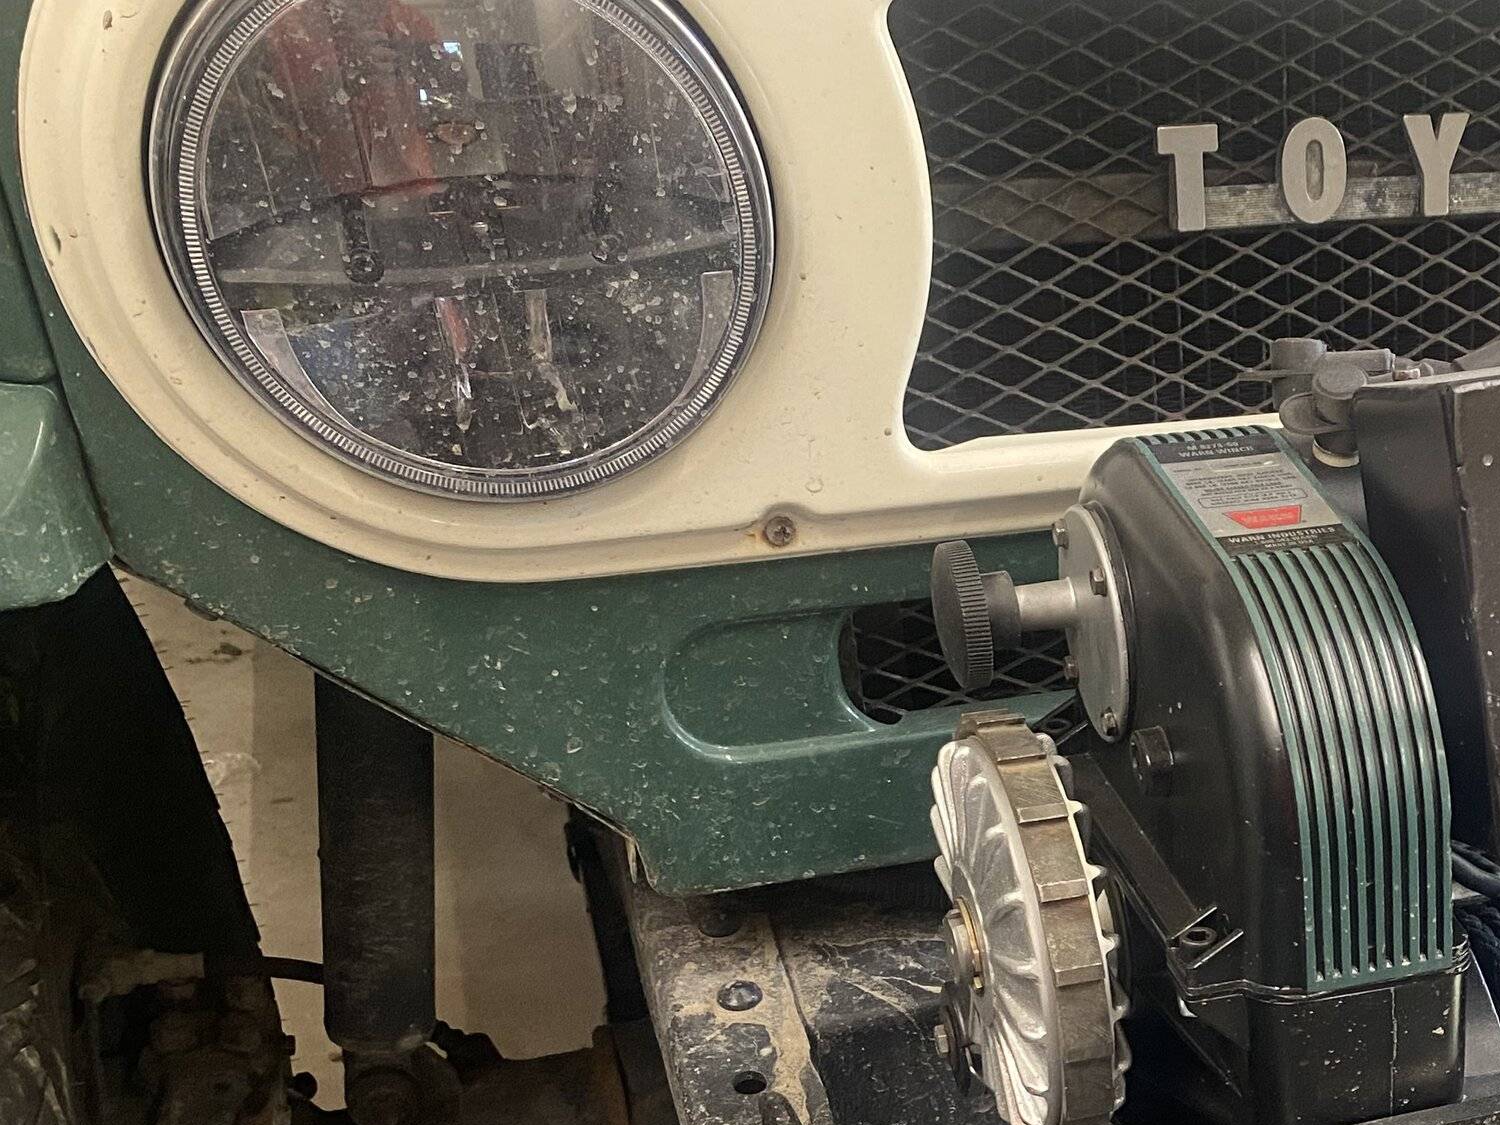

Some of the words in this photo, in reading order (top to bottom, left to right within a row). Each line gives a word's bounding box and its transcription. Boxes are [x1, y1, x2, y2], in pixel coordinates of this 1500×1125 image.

[1179, 449, 1214, 458] WARN
[1216, 446, 1254, 455] WINCH
[1228, 534, 1265, 543] WARN
[1267, 527, 1336, 540] INDUSTRIES
